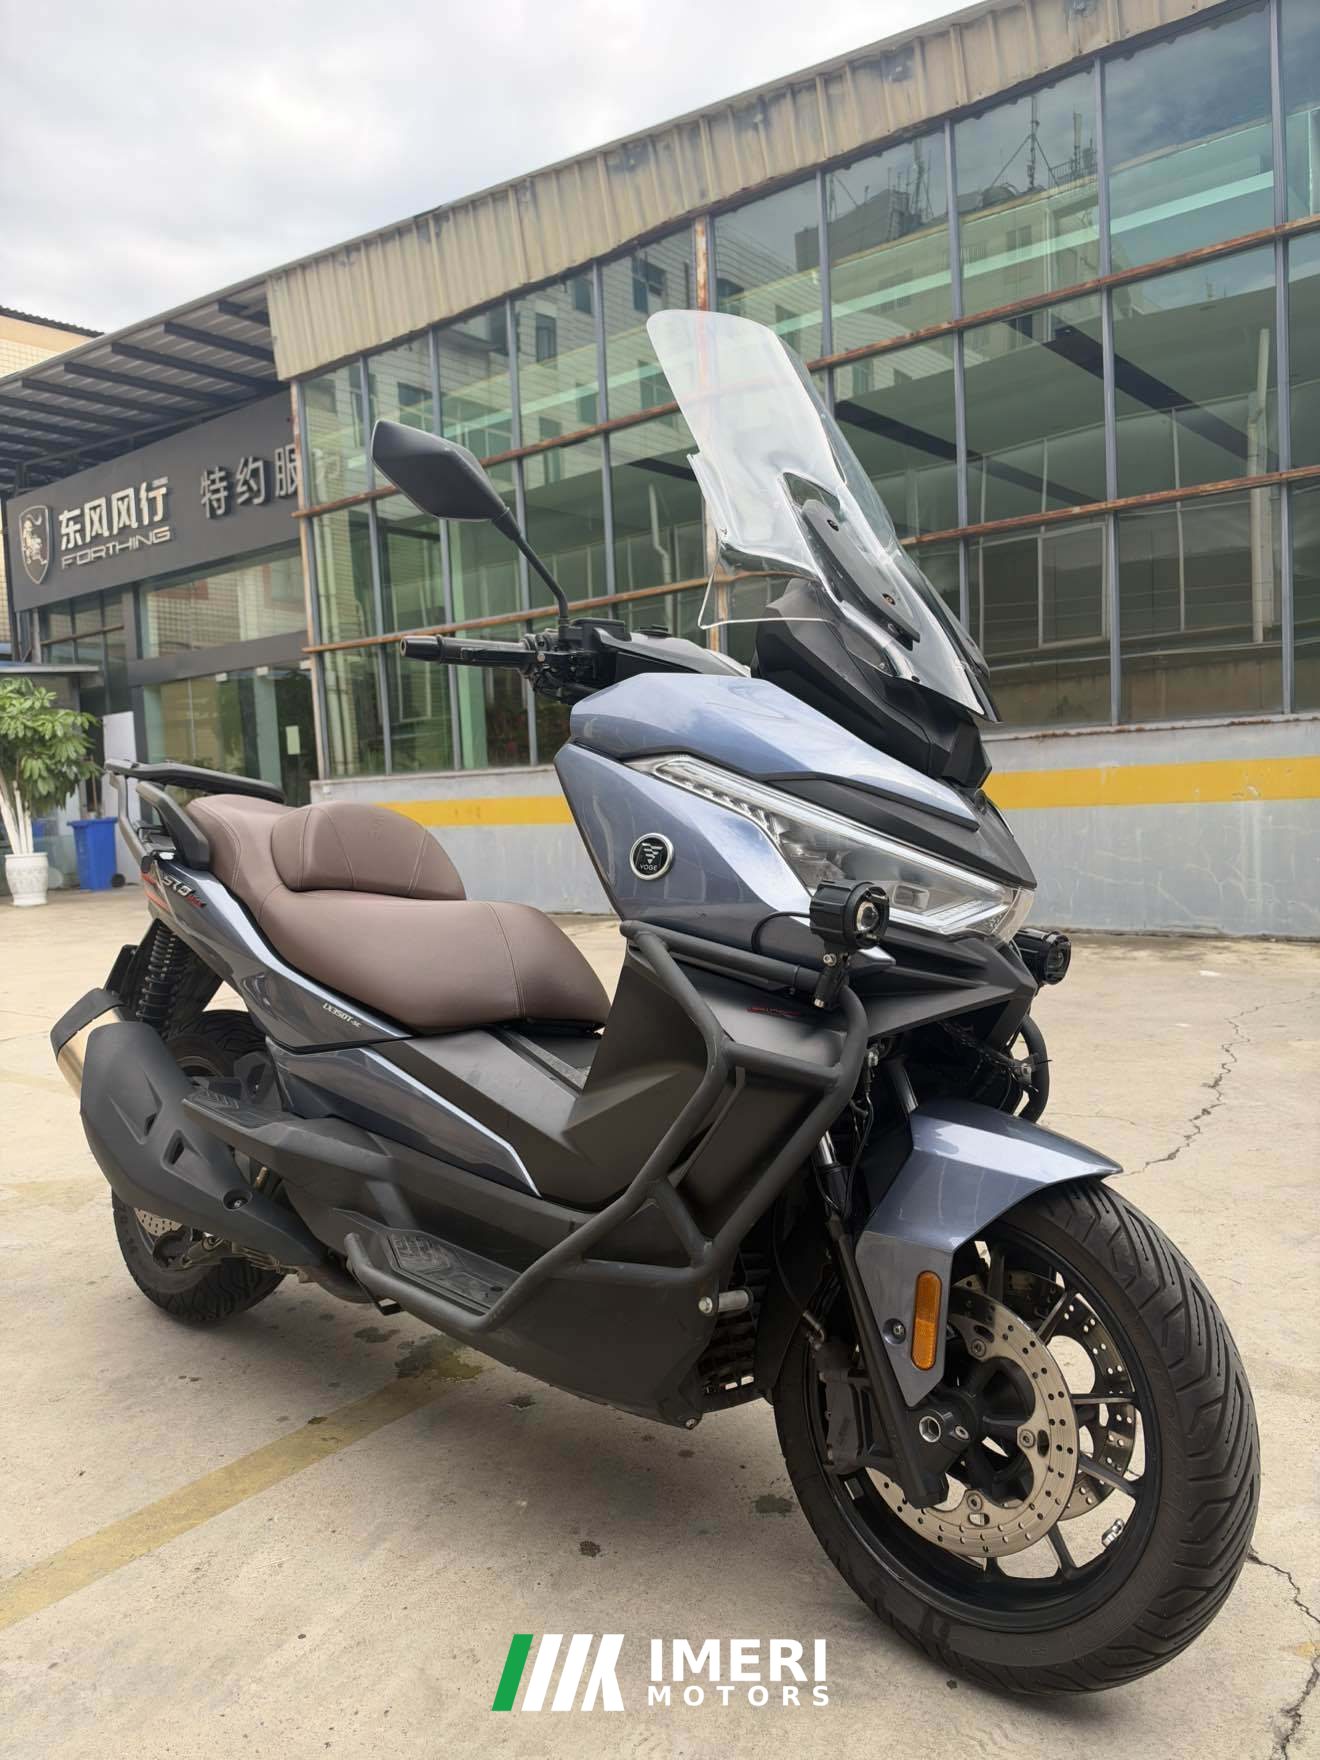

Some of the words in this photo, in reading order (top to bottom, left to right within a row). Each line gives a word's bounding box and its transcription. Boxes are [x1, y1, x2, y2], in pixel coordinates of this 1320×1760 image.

[58, 476, 169, 551] 东风风行
[201, 443, 298, 519] 特约服
[61, 526, 171, 569] FORTHING
